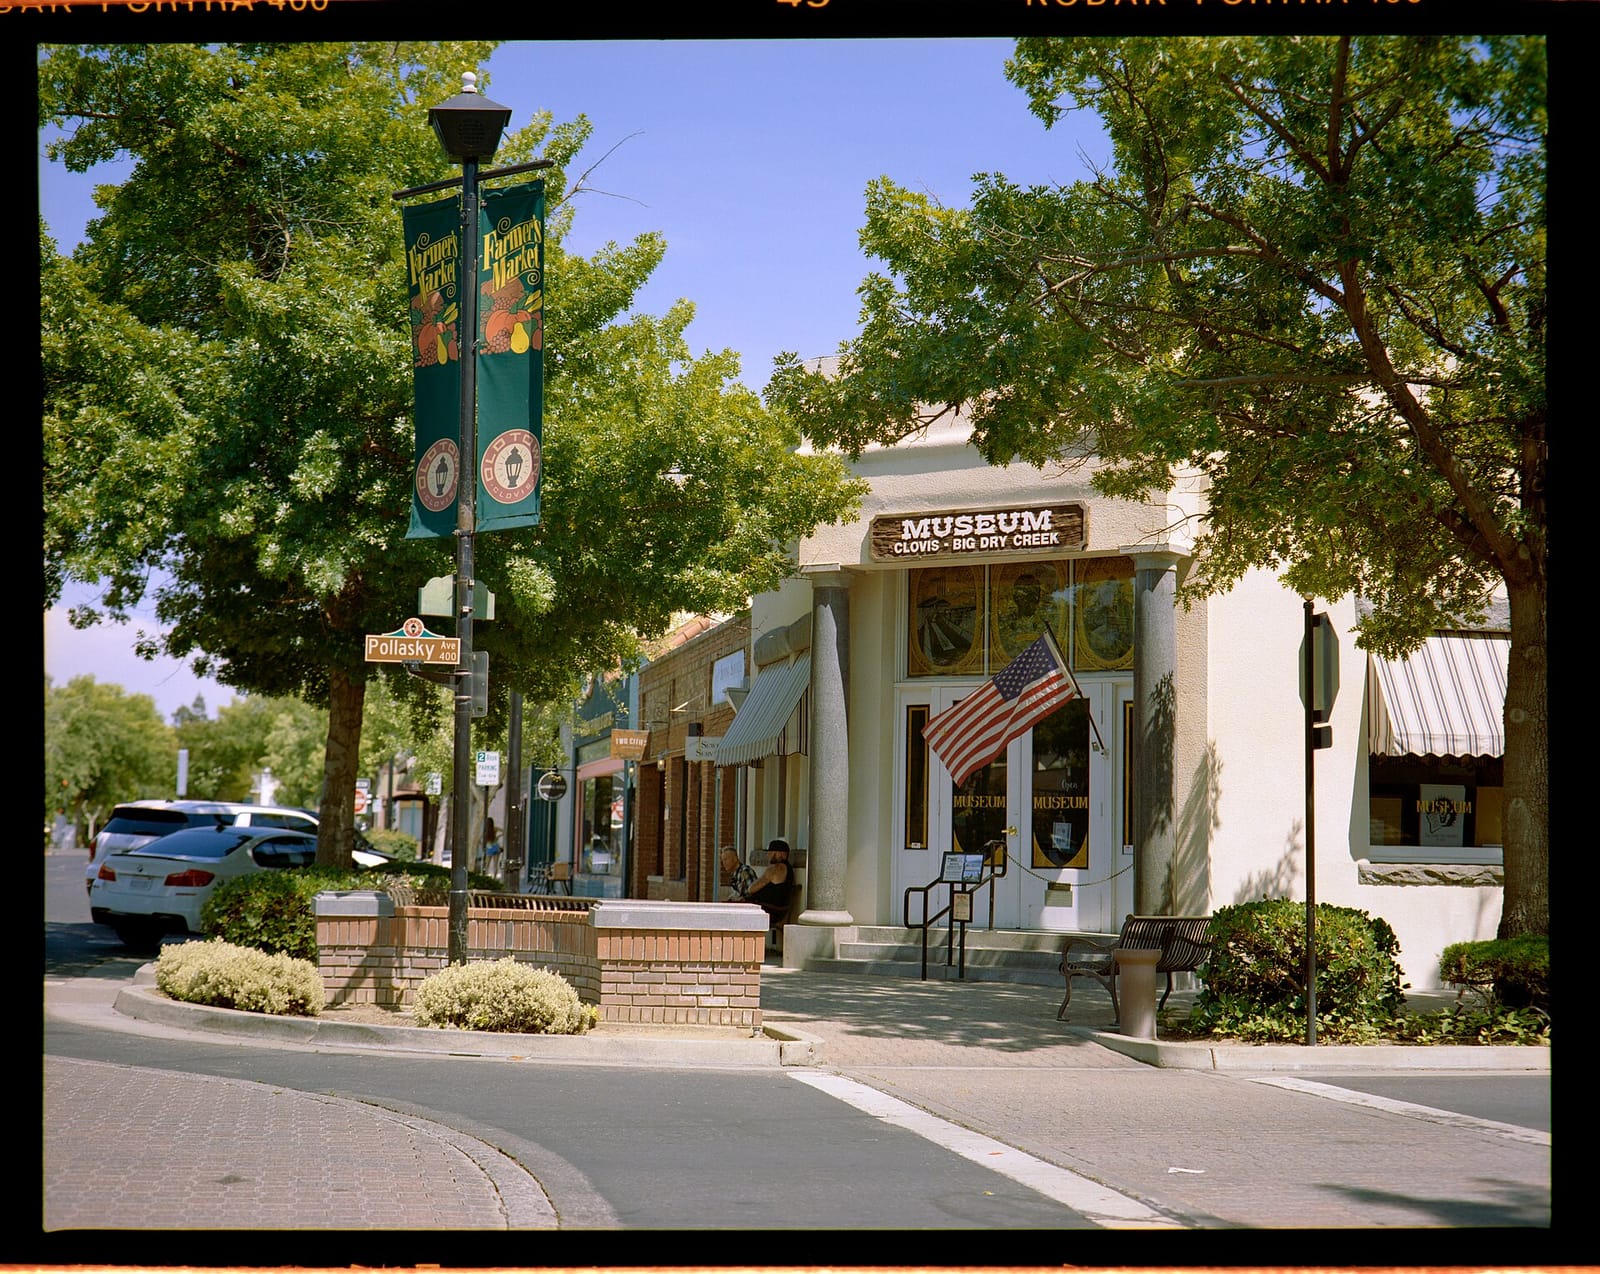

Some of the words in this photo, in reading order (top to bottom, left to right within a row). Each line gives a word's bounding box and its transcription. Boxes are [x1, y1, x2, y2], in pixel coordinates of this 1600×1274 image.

[482, 214, 542, 271] Farmer's
[491, 244, 540, 294] Market
[418, 448, 438, 490] OLD
[485, 437, 506, 482] OLD
[900, 509, 1053, 541] MUSEUM
[894, 539, 939, 554] CLOVIS
[952, 537, 976, 551] BIG
[980, 536, 1007, 549] DRY
[1013, 532, 1060, 546] CREEK
[368, 638, 435, 660] Pollasky
[440, 641, 457, 650] Ave
[439, 652, 457, 661] 400
[478, 753, 485, 761] 2
[953, 795, 1007, 808] MUSEUM
[1033, 796, 1088, 809] MUSEUM
[1416, 800, 1472, 814] MUSEUM
